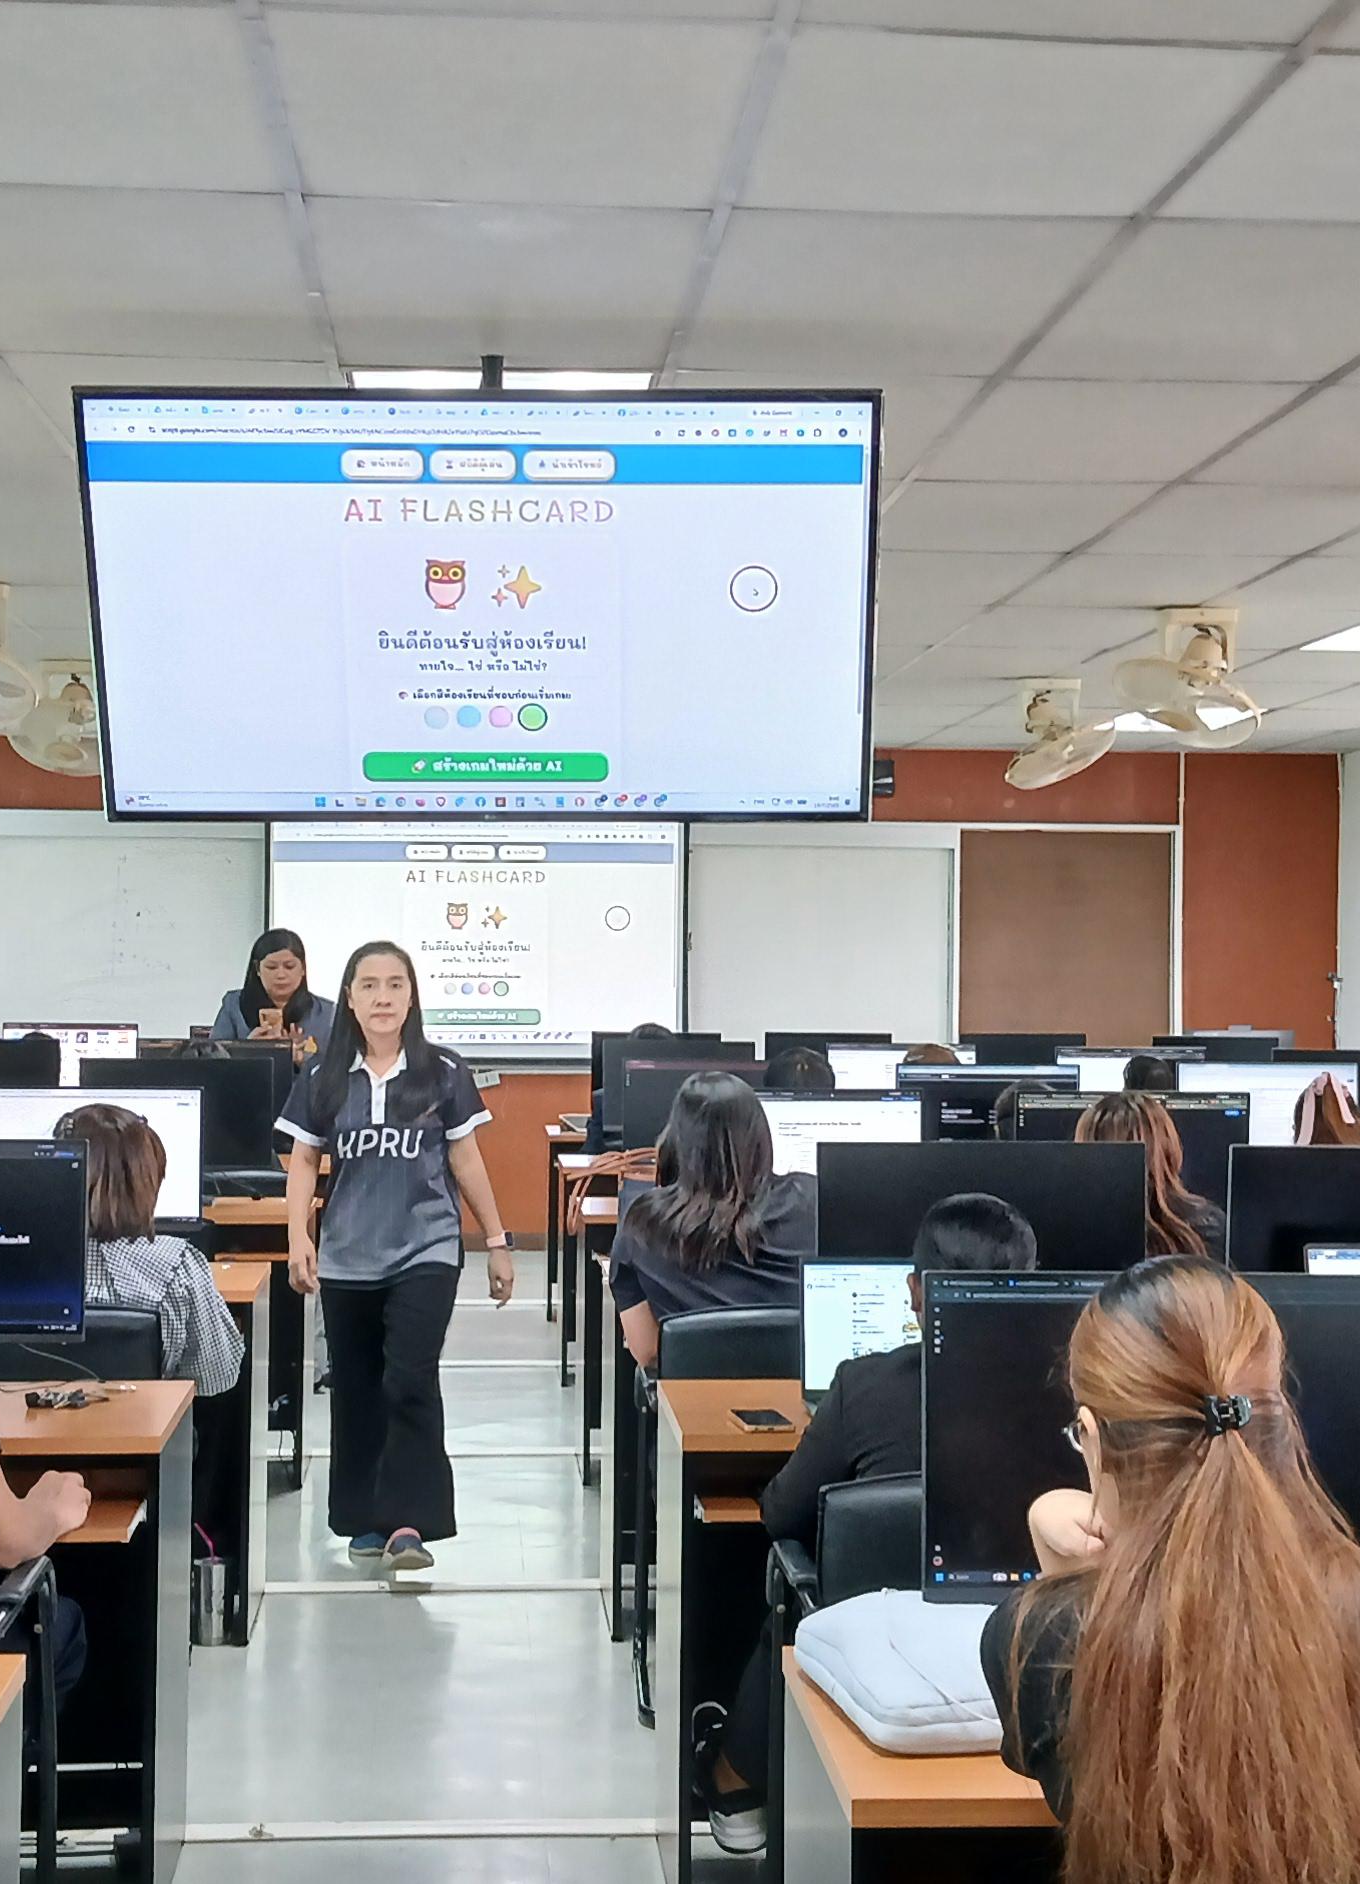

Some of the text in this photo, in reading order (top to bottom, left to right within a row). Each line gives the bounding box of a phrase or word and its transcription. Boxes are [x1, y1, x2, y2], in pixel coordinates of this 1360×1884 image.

[344, 497, 614, 523] AI FLASHCARD
[378, 630, 587, 657] ยินดีต้อนรับสู่ห้องเรียน!
[433, 756, 562, 773] สร้างเกมใหม่ด้วย AI
[406, 869, 546, 884] AI FLASHCARD
[337, 1127, 424, 1159] KPRU
